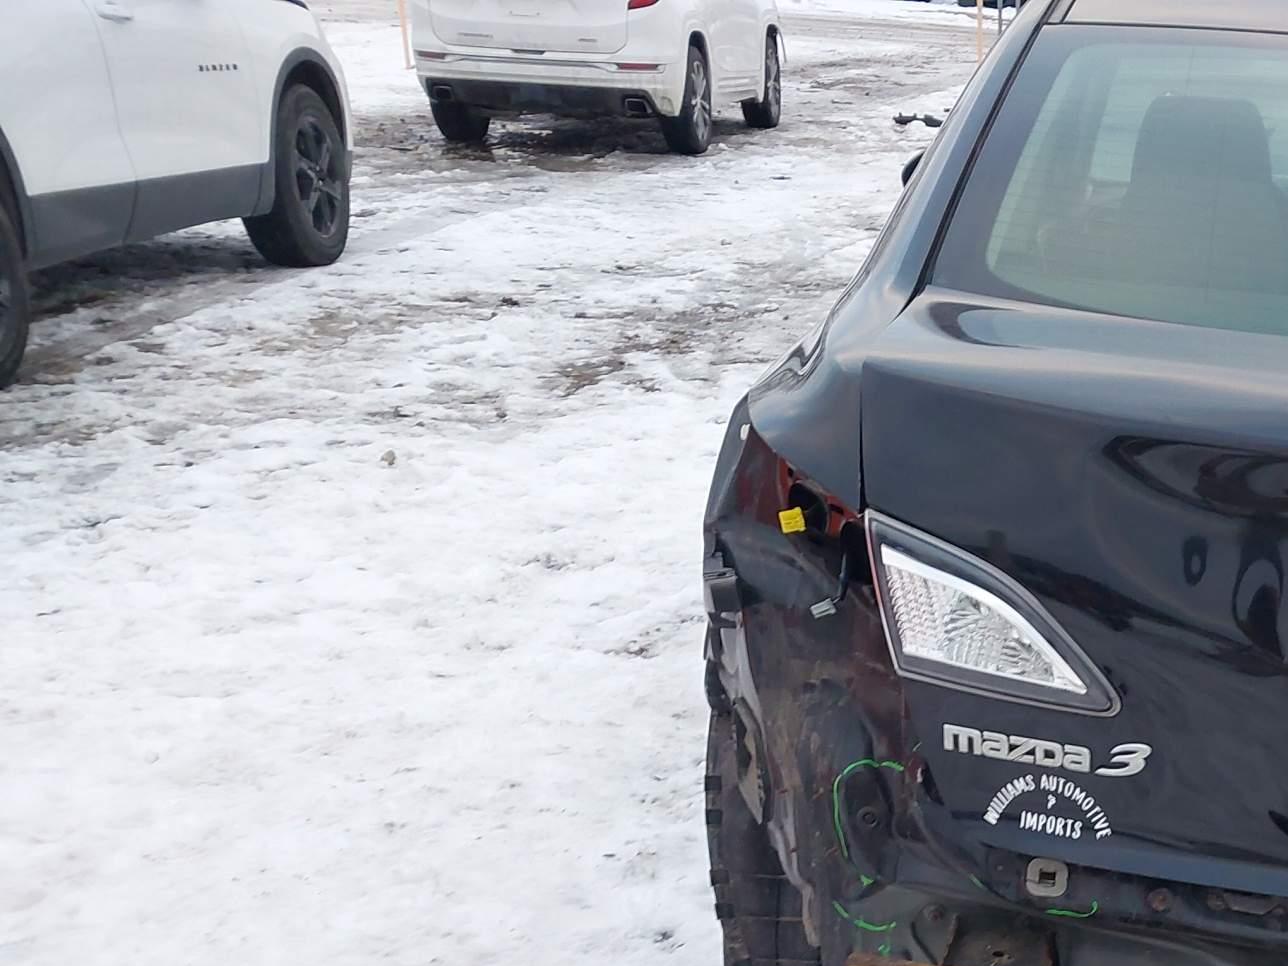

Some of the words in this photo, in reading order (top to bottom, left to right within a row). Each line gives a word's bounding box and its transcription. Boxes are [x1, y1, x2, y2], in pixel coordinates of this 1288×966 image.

[1095, 742, 1152, 776] 3
[983, 774, 1036, 825] WILLIAMS
[1040, 773, 1112, 840] AUTOMOTIVE
[1019, 811, 1083, 840] IMPORTS
